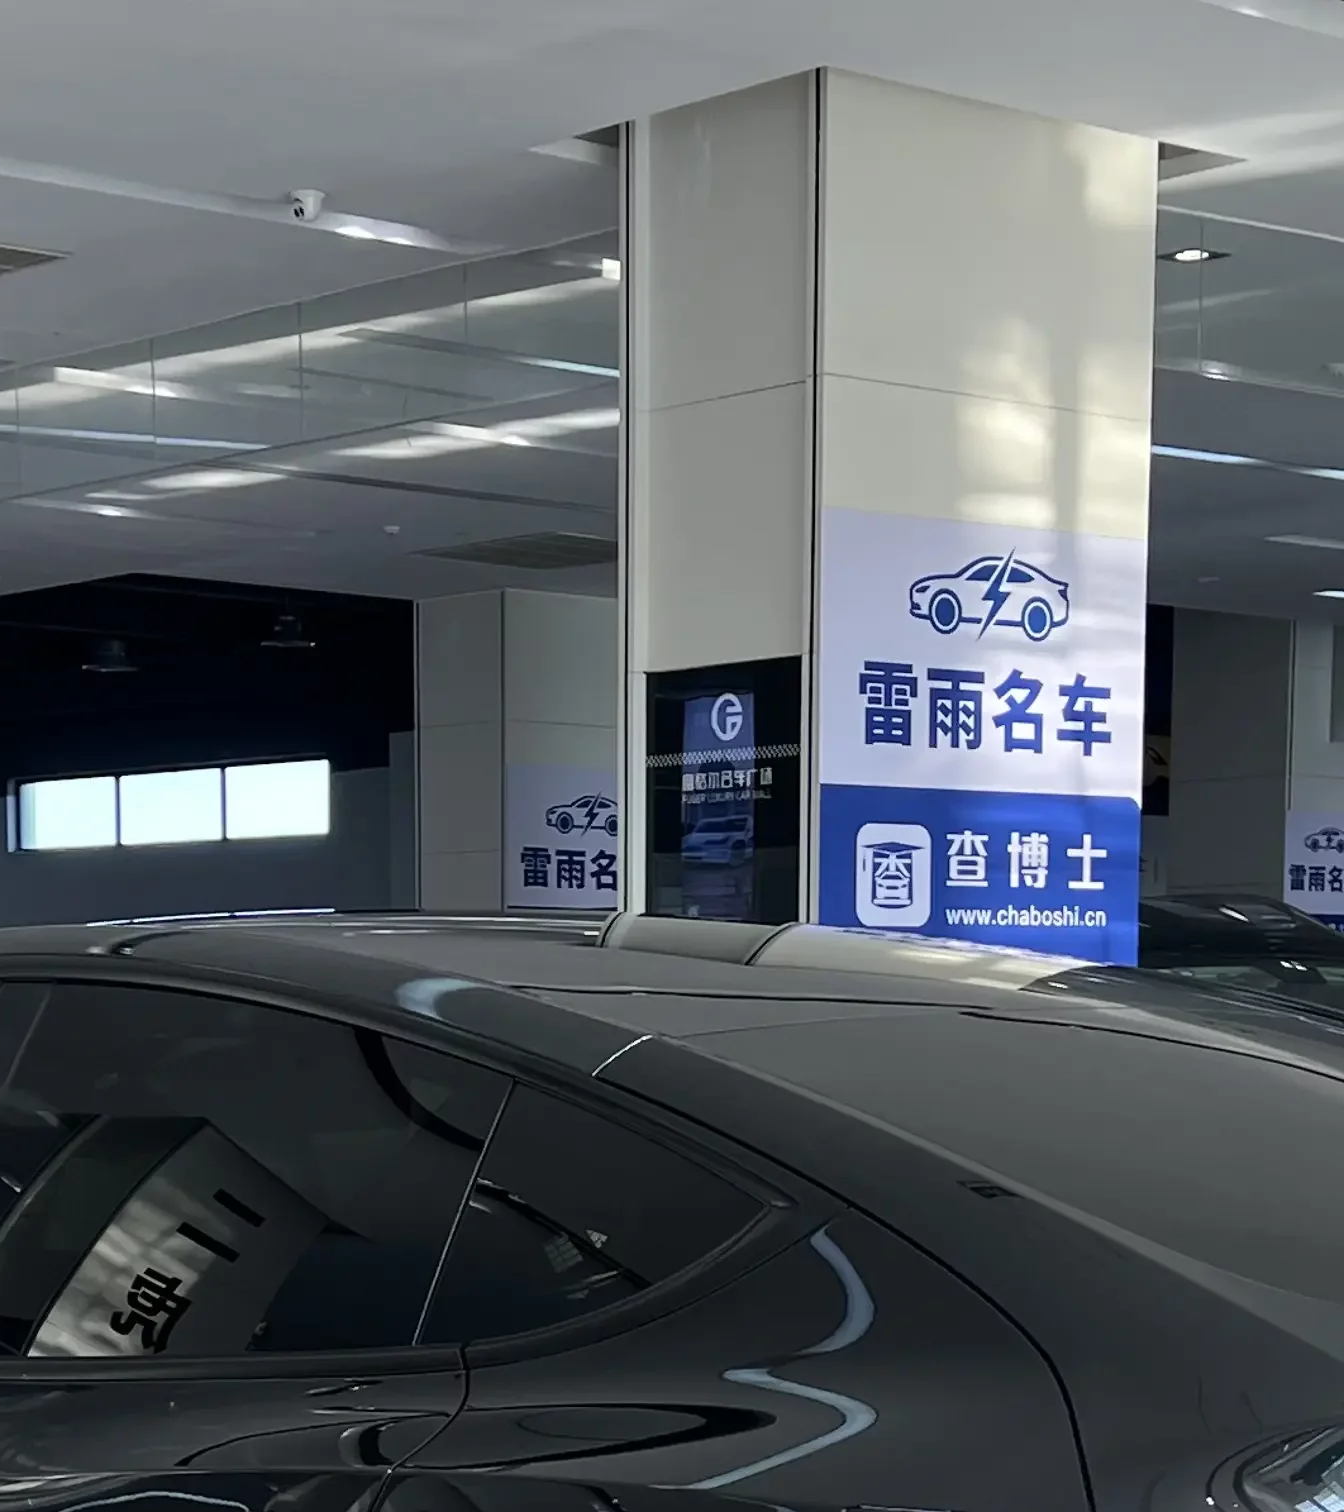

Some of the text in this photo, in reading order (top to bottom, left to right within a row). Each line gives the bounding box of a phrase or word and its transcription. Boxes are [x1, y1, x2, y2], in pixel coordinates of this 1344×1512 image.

[859, 661, 1112, 756] 雷雨名车
[520, 847, 618, 891] 雷雨名
[945, 830, 1108, 890] 查博士
[945, 904, 1107, 927] www.chaboshi.cn
